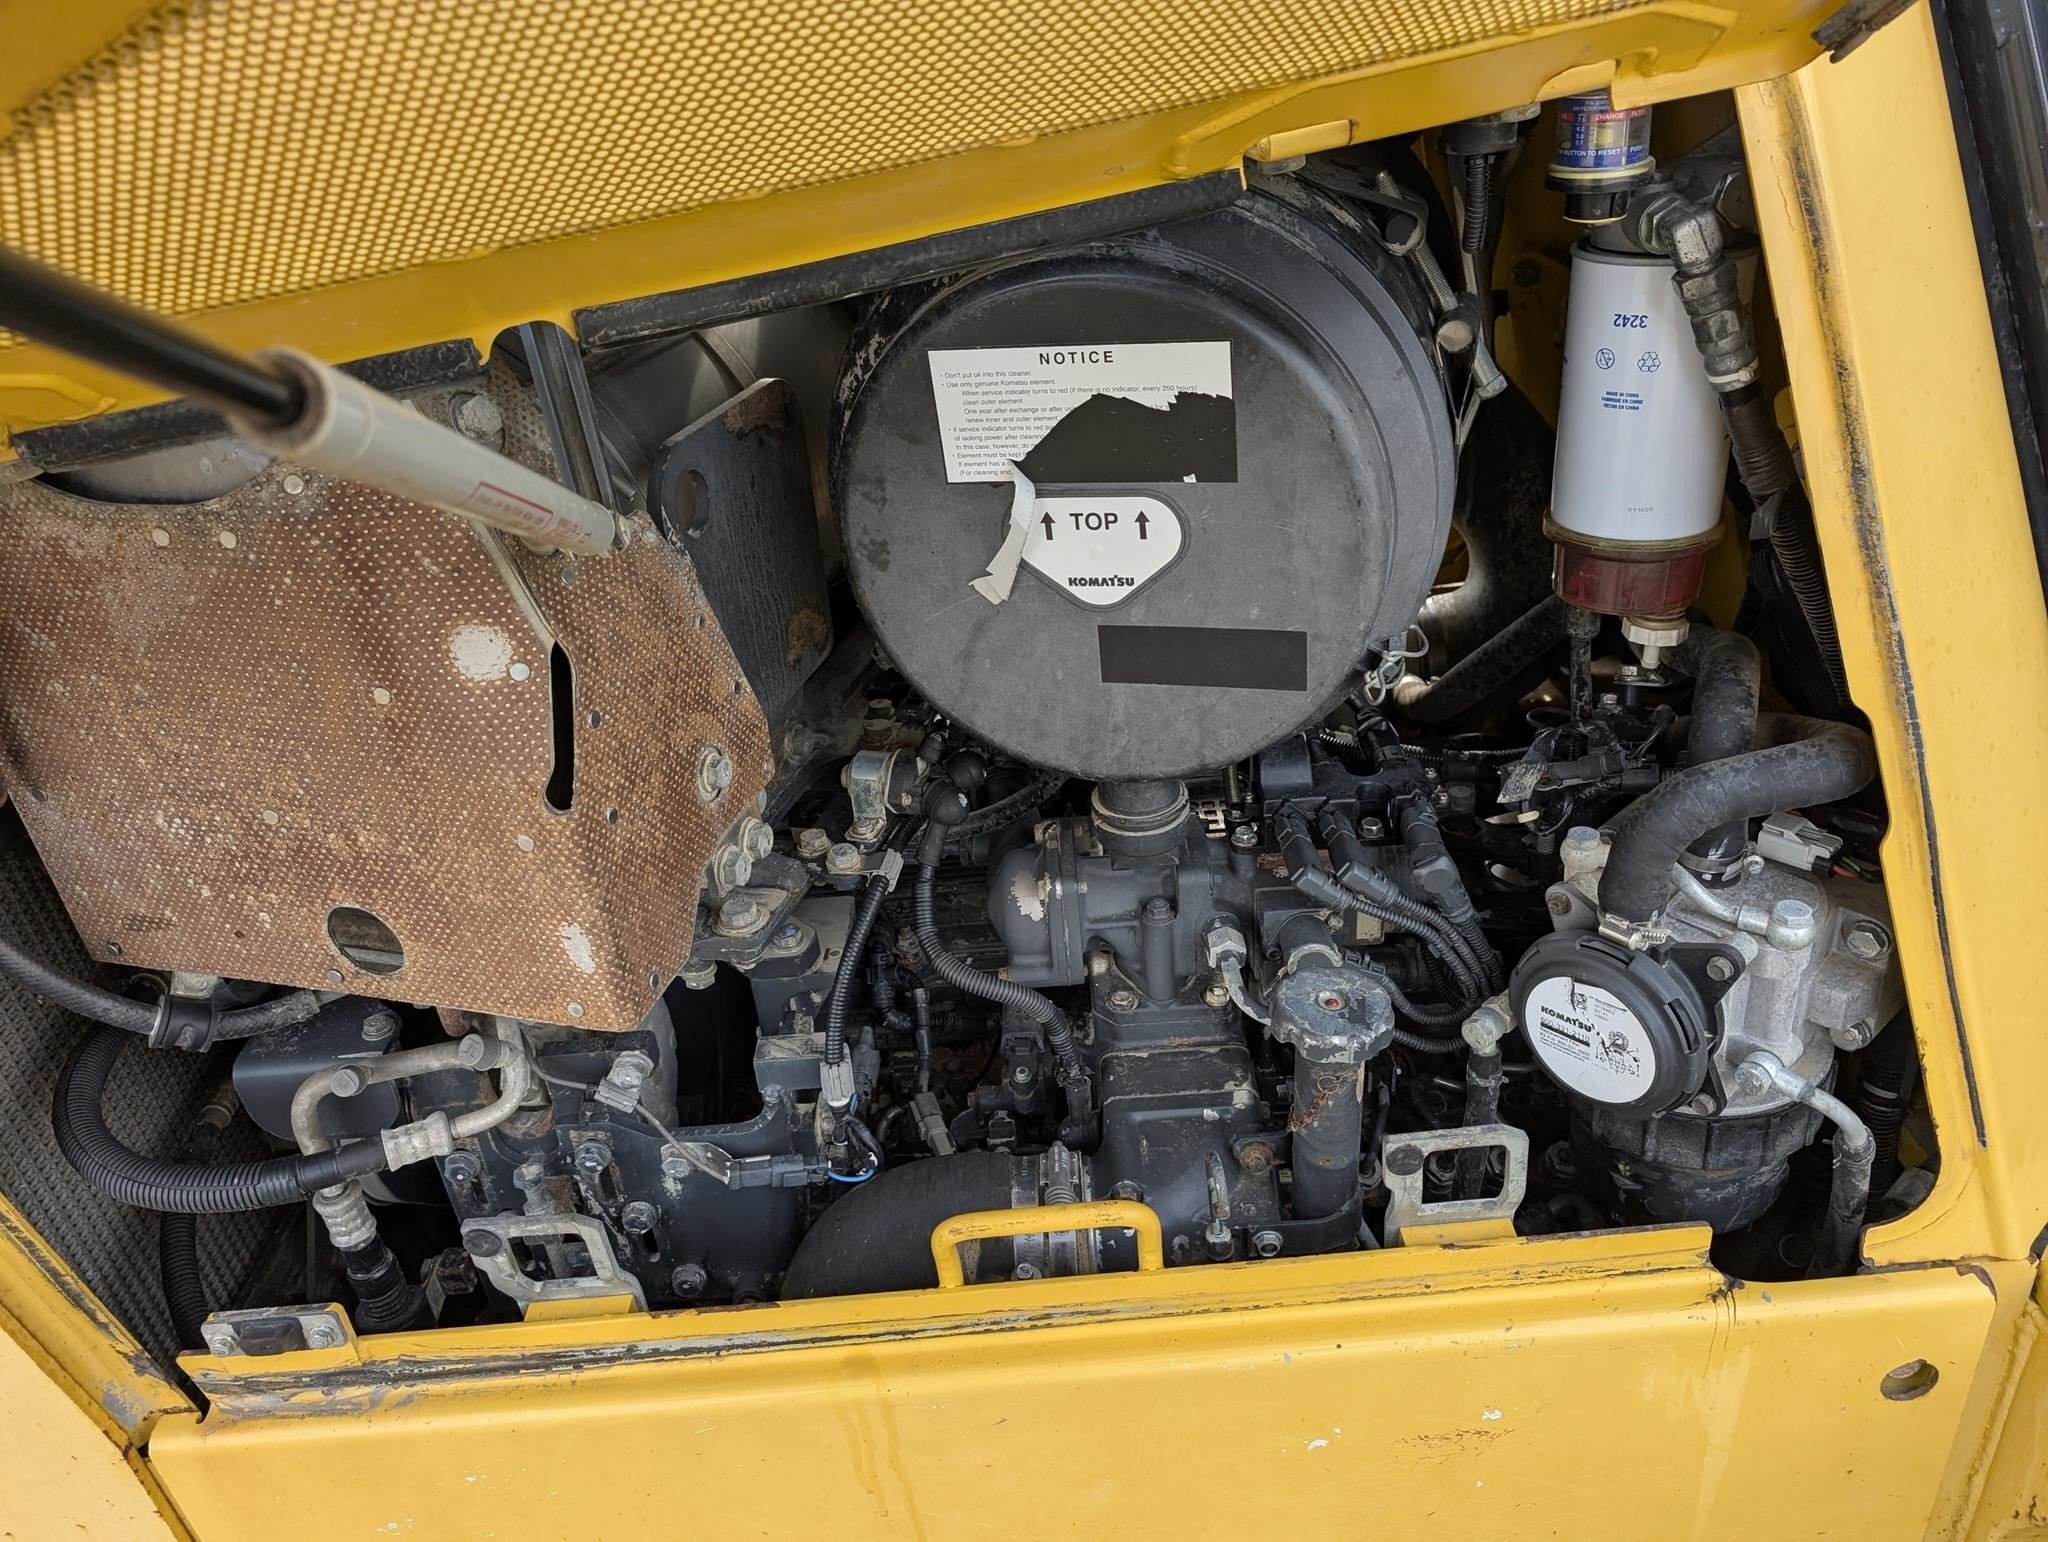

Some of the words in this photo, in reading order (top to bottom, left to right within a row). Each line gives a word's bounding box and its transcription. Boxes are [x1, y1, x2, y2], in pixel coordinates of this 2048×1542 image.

[1595, 112, 1625, 121] CHANGE
[1598, 148, 1621, 156] RESET
[1613, 313, 1649, 329] 3242
[1039, 350, 1115, 366] NOTICE
[974, 380, 999, 388] genuine
[1111, 385, 1141, 393] indicator,
[1008, 406, 1040, 414] exchange
[961, 434, 983, 442] lacking
[984, 434, 1004, 442] power
[992, 442, 1021, 450] however,
[1008, 451, 1021, 459] kept
[1069, 512, 1119, 531] TOP
[1068, 574, 1135, 587] KOMATSU
[1541, 1005, 1592, 1033] KOMATSU
[1540, 1016, 1590, 1043] 600-331-2110
